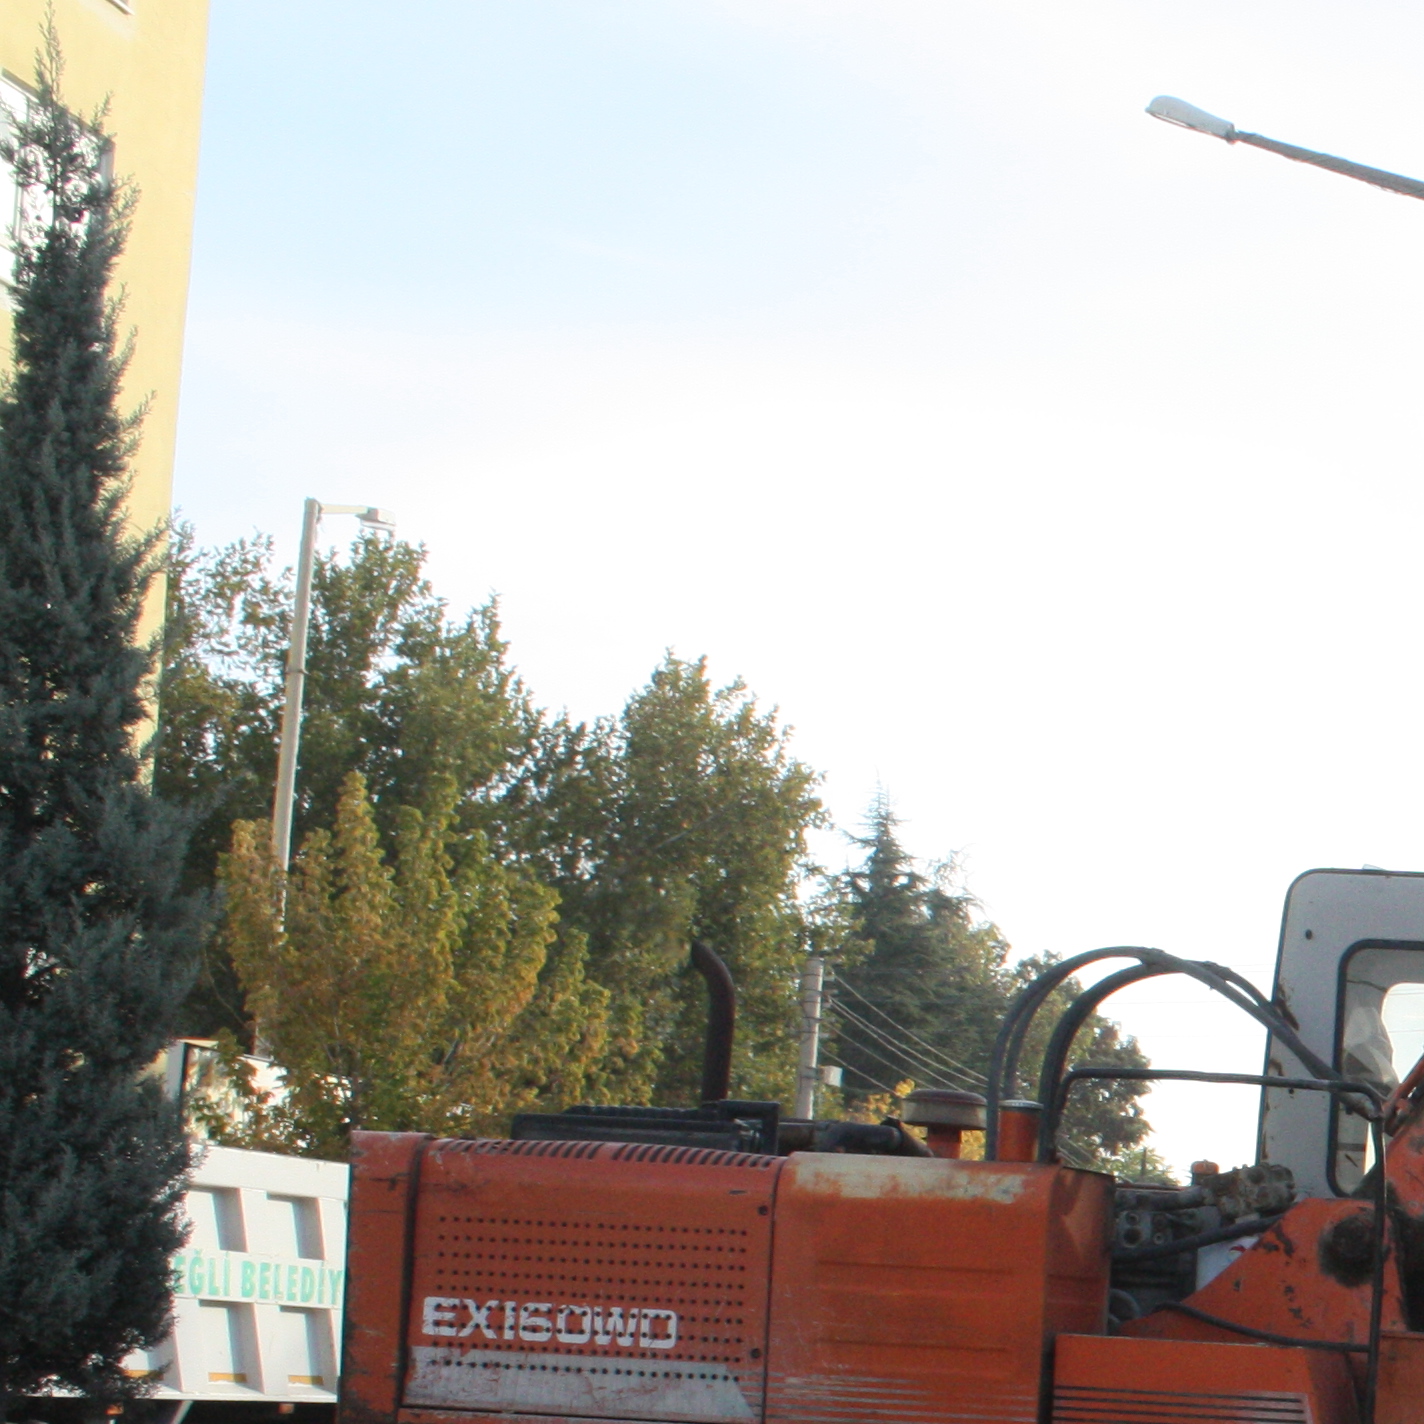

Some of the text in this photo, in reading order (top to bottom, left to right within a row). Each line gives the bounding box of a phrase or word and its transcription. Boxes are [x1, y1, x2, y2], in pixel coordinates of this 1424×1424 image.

[173, 1249, 343, 1306] EĞLİ BELEDİY
[422, 1296, 678, 1349] EX160WD
